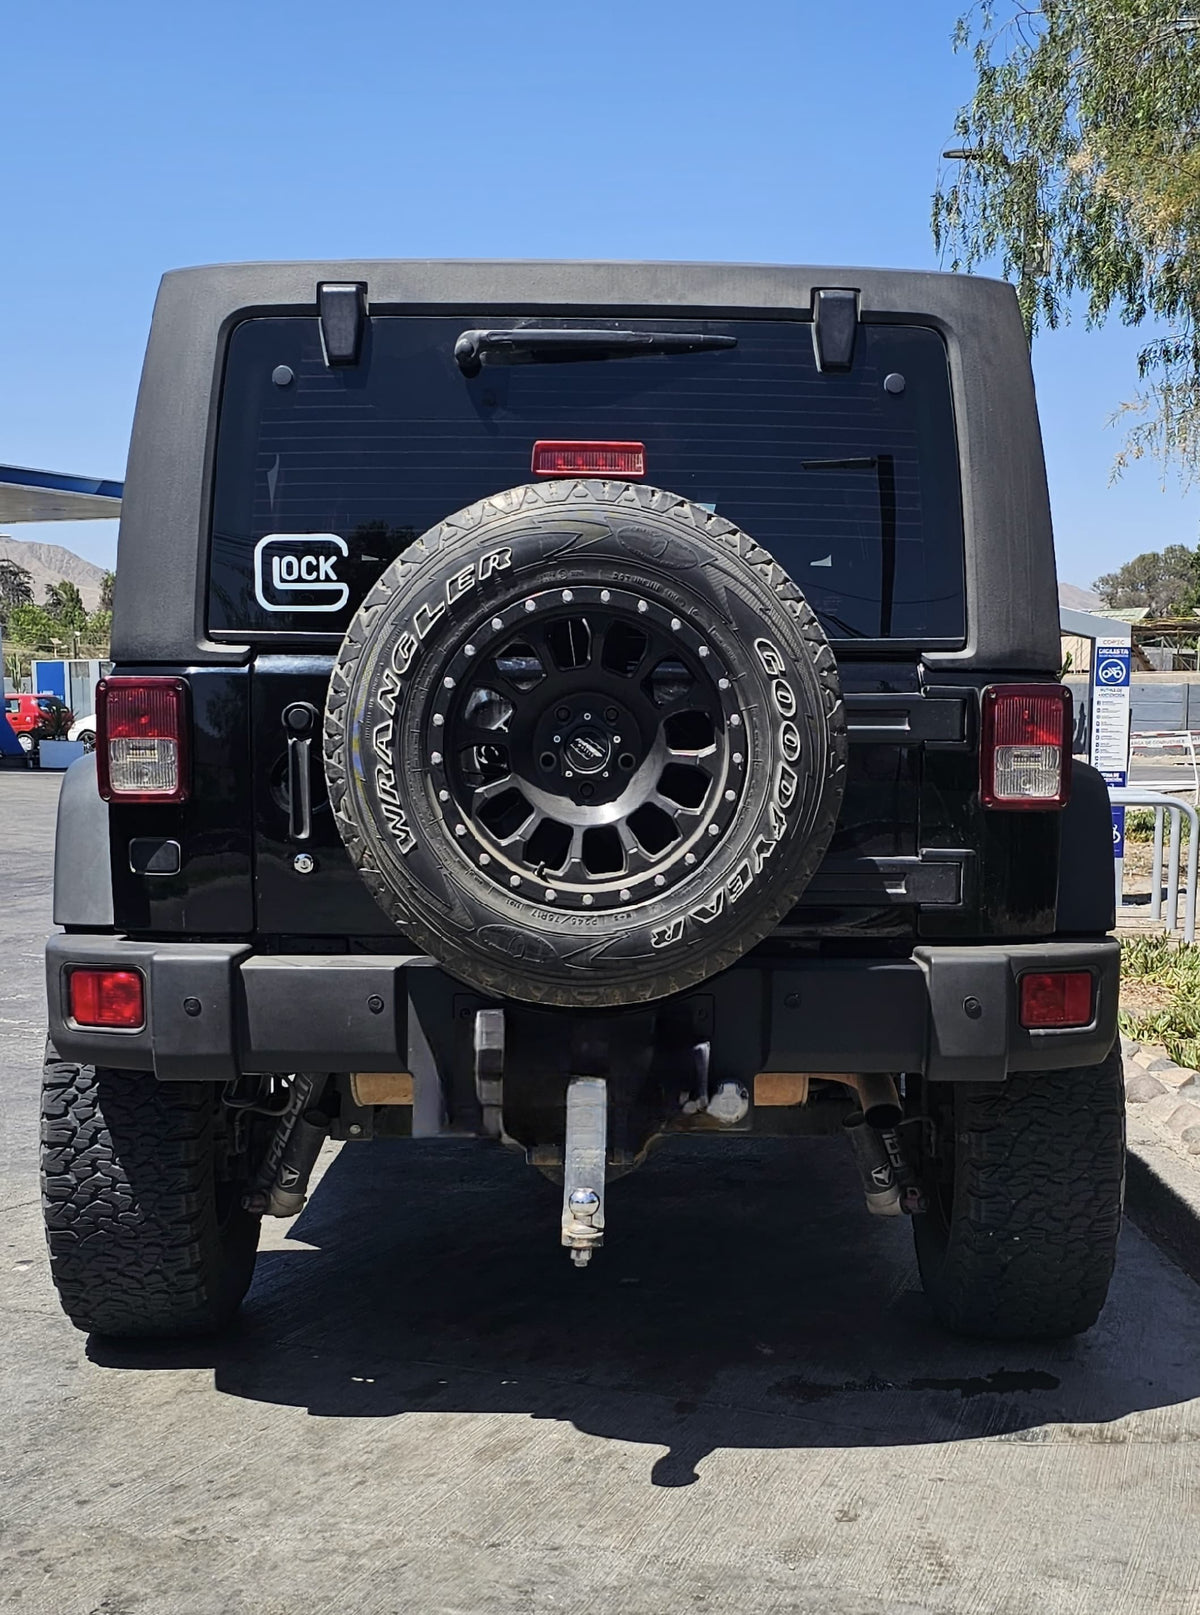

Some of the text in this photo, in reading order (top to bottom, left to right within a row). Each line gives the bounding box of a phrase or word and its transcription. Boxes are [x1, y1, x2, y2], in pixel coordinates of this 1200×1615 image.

[254, 533, 349, 612] GLOCK
[374, 547, 513, 855] WRANGLER
[651, 638, 800, 948] GOODYEAR
